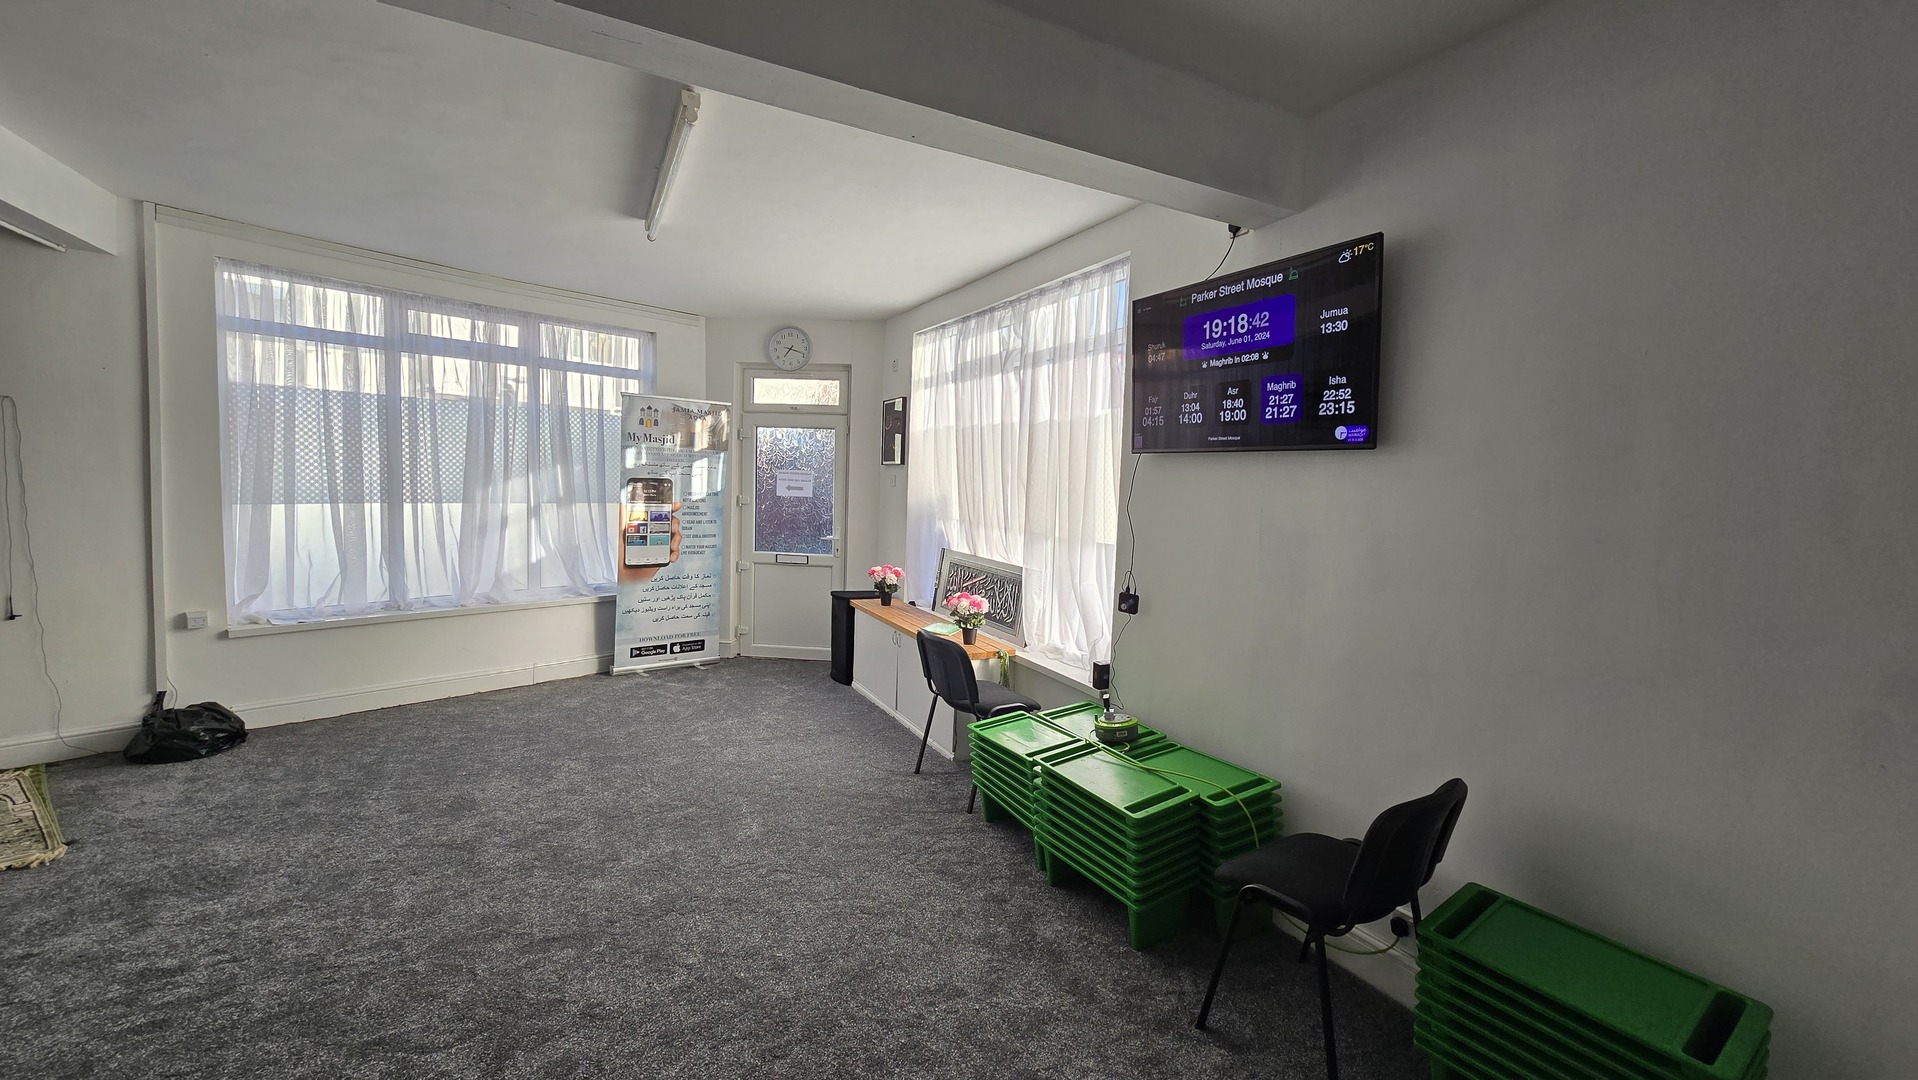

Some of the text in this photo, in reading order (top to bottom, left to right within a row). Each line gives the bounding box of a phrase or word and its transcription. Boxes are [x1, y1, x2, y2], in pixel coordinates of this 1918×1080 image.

[1353, 242, 1375, 256] 17°C
[1191, 272, 1284, 304] Parker Street Mosque
[1319, 306, 1349, 319] Jumua
[1203, 311, 1270, 340] 19:18:42
[1320, 319, 1349, 334] 13:30
[1201, 331, 1271, 350] Saturday, June 01, 2024
[1147, 352, 1166, 363] 04:47
[1209, 356, 1234, 368] Maghrib
[1240, 352, 1260, 363] 02:08
[1266, 380, 1297, 392] Maghrib
[1328, 375, 1347, 385] Isha
[1183, 391, 1198, 400] Duhr
[1227, 386, 1239, 396] Asr
[1322, 387, 1352, 401] 22:52
[1222, 398, 1244, 409] 18:40
[1268, 393, 1294, 406] 21:27
[1144, 406, 1162, 416] 01:57
[1181, 402, 1200, 412] 13:04
[1265, 405, 1297, 419] 21:27
[1318, 400, 1356, 416] 23:15
[1142, 416, 1165, 427] 04:15
[1178, 412, 1203, 425] 14:00
[1219, 409, 1247, 422] 19:00
[627, 431, 675, 447] My Masjid
[639, 633, 674, 643] DOWNLOAD
